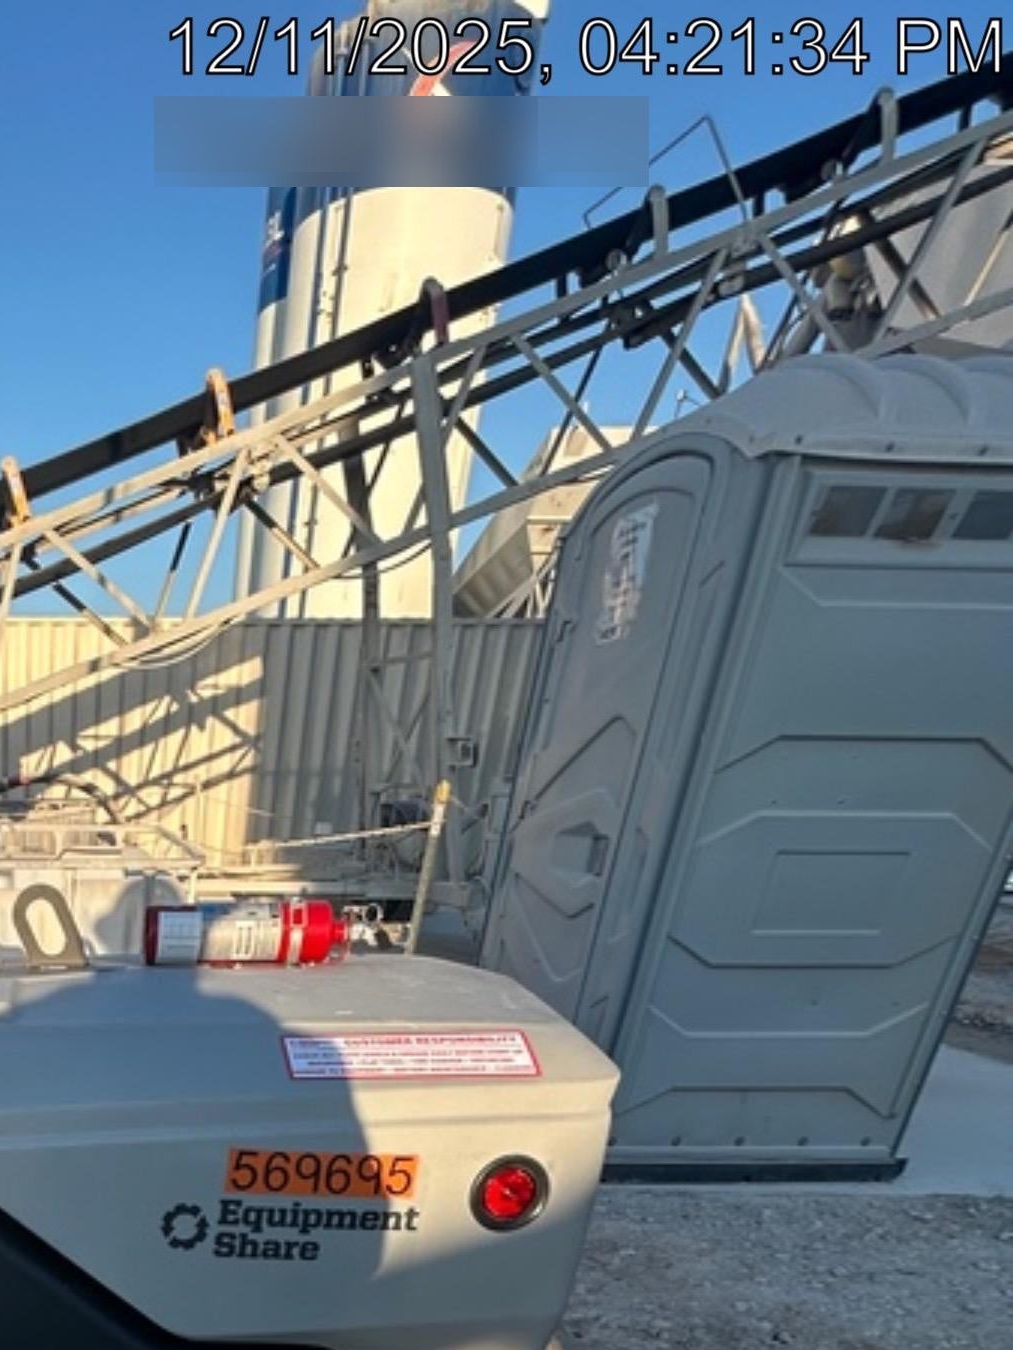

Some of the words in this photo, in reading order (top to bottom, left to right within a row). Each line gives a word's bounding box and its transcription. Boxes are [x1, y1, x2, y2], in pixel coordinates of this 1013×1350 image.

[230, 1150, 415, 1195] 569695
[218, 1199, 420, 1234] Equipment
[213, 1231, 321, 1261] Share
